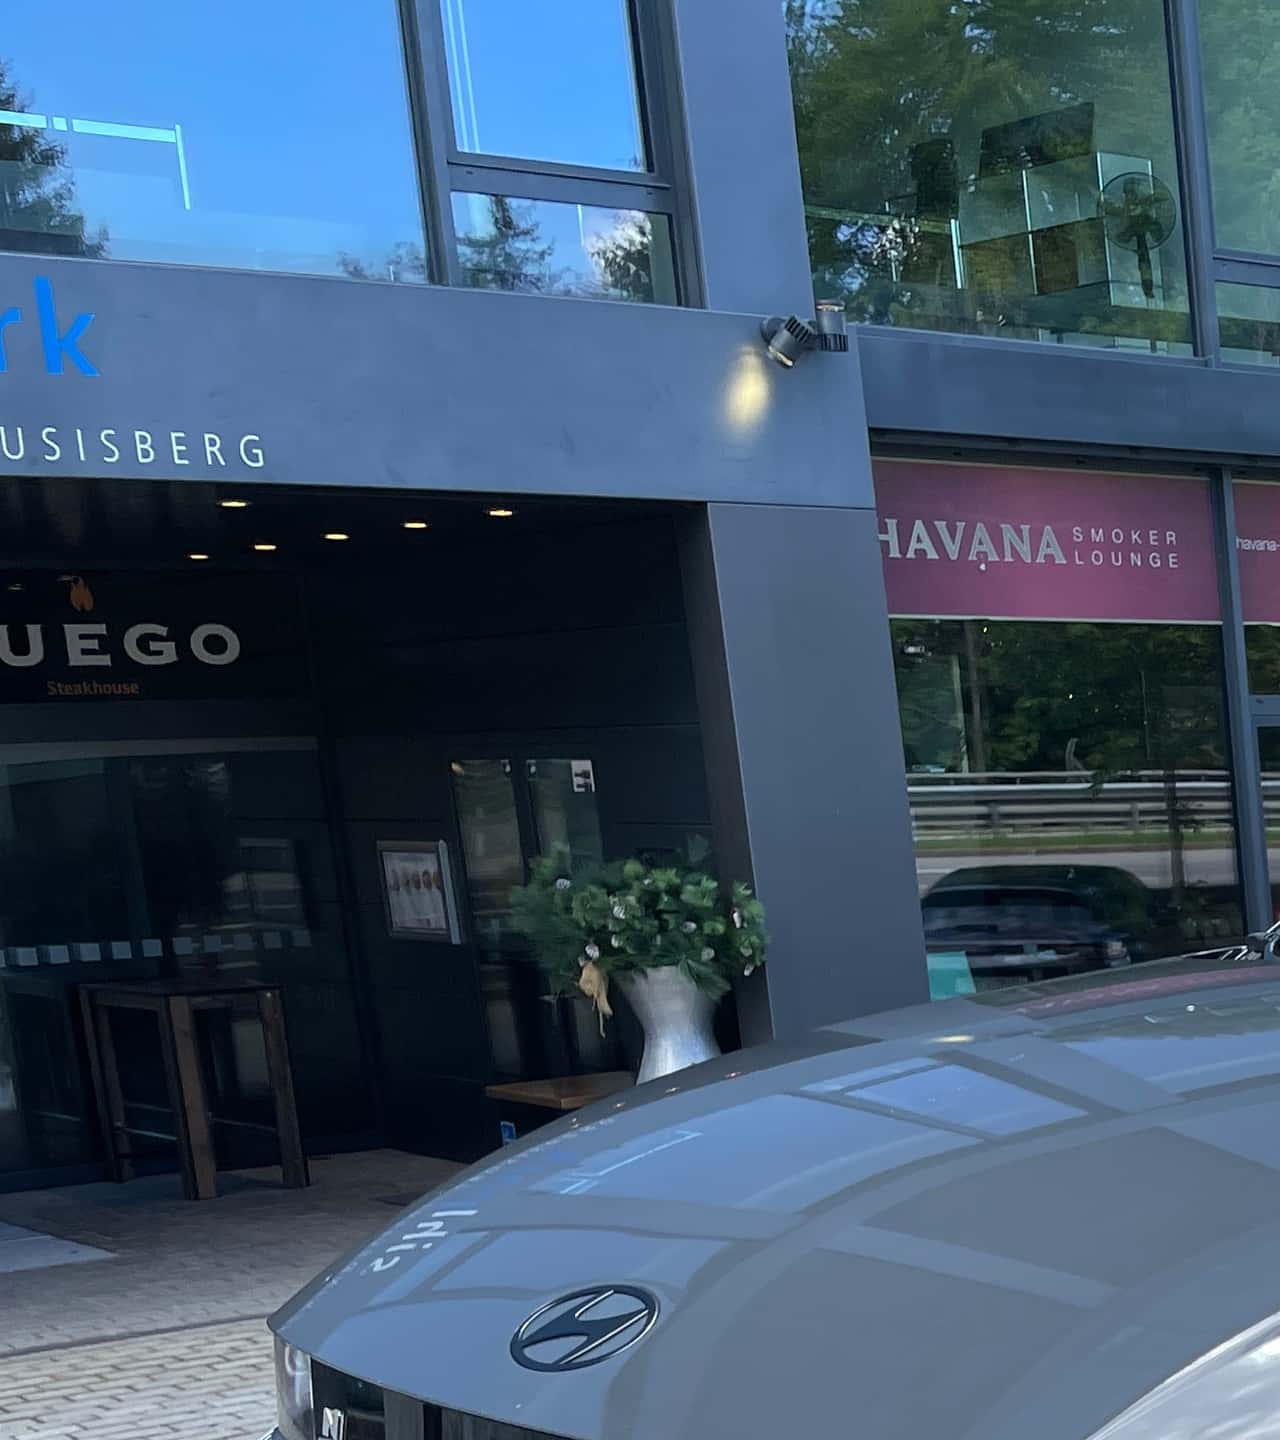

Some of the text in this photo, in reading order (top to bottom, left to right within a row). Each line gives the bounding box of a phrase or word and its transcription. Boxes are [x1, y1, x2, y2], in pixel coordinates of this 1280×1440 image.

[0, 426, 265, 468] USISBERG
[878, 517, 1068, 565] HAVANA
[1072, 526, 1177, 545] SMOKER
[1074, 550, 1178, 568] LOUNGE
[0, 623, 241, 667] UEGO
[47, 681, 140, 696] Steakhouse
